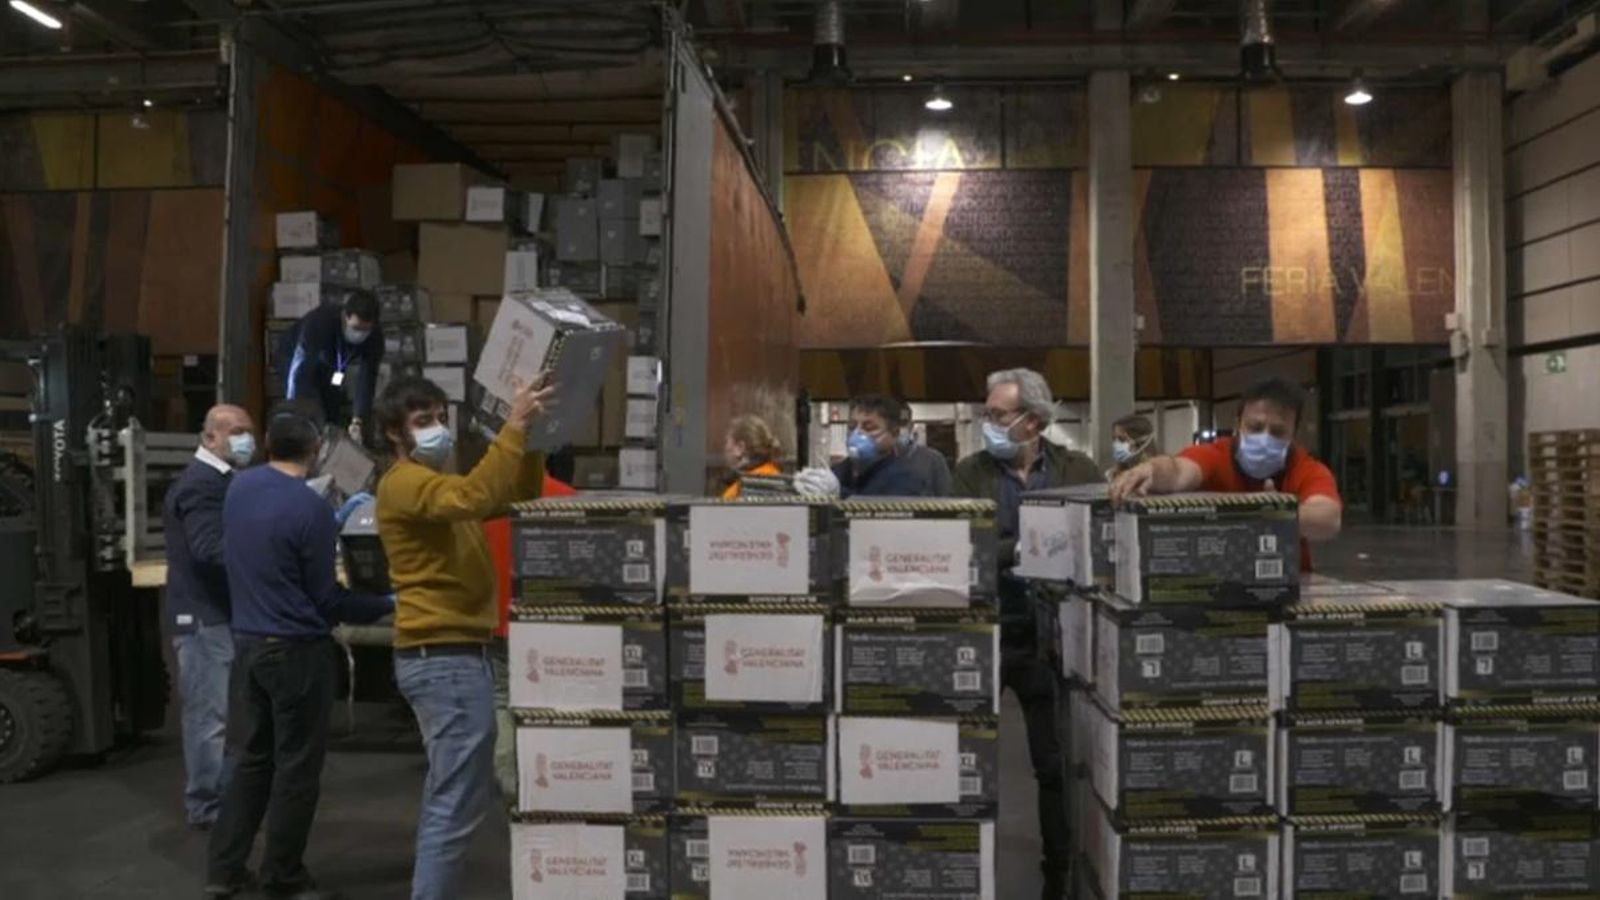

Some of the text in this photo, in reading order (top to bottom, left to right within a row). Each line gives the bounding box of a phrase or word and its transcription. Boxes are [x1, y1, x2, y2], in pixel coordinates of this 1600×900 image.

[1241, 266, 1342, 296] FERIA
[708, 552, 774, 561] GENERALITAT
[886, 552, 951, 563] GENERALITAT
[886, 563, 949, 574] VALENCIANA
[740, 648, 805, 657] GENERALITAT
[542, 656, 605, 667] GENERALITAT
[742, 658, 804, 668] VALENCIANA
[545, 667, 604, 677] VALENCIANA
[876, 750, 941, 760] GENERALITAT
[550, 760, 613, 770] GENERALITAT
[878, 760, 940, 770] VALENCIANA
[552, 771, 612, 781] VALENCIANA
[546, 857, 607, 866] GENERALITAT
[726, 859, 790, 869] GENERALITAT
[548, 867, 606, 877] VALENCIANA
